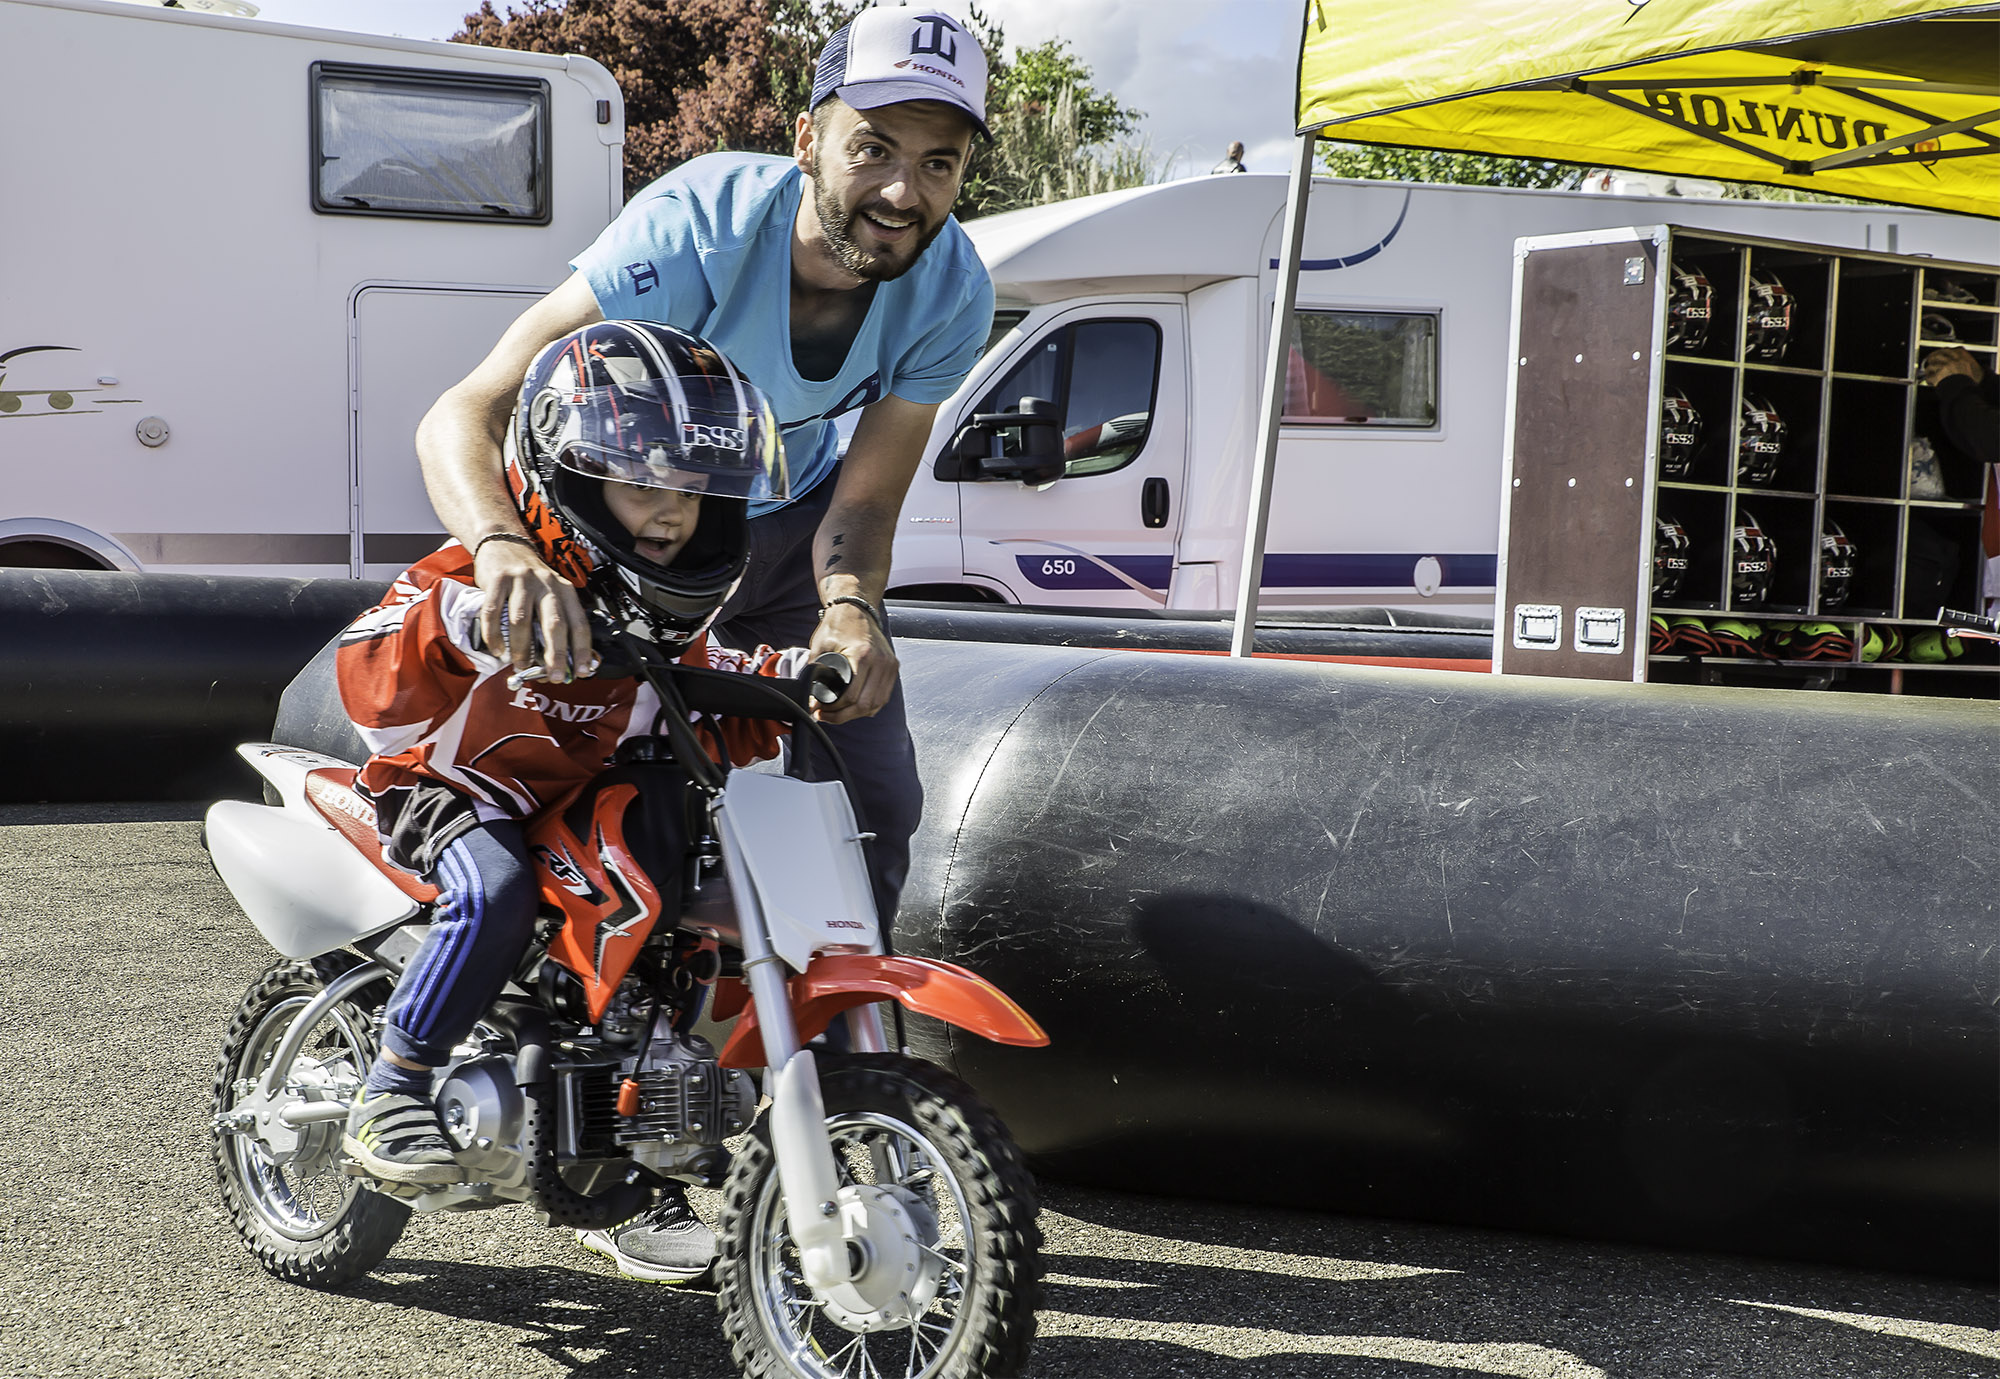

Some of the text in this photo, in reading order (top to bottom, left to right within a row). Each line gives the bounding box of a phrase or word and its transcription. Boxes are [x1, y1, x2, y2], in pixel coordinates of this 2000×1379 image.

[912, 63, 966, 88] HONDA
[1041, 559, 1076, 576] 650
[508, 687, 619, 723] HOND
[317, 782, 379, 830] HOND
[825, 920, 866, 930] HONDA
